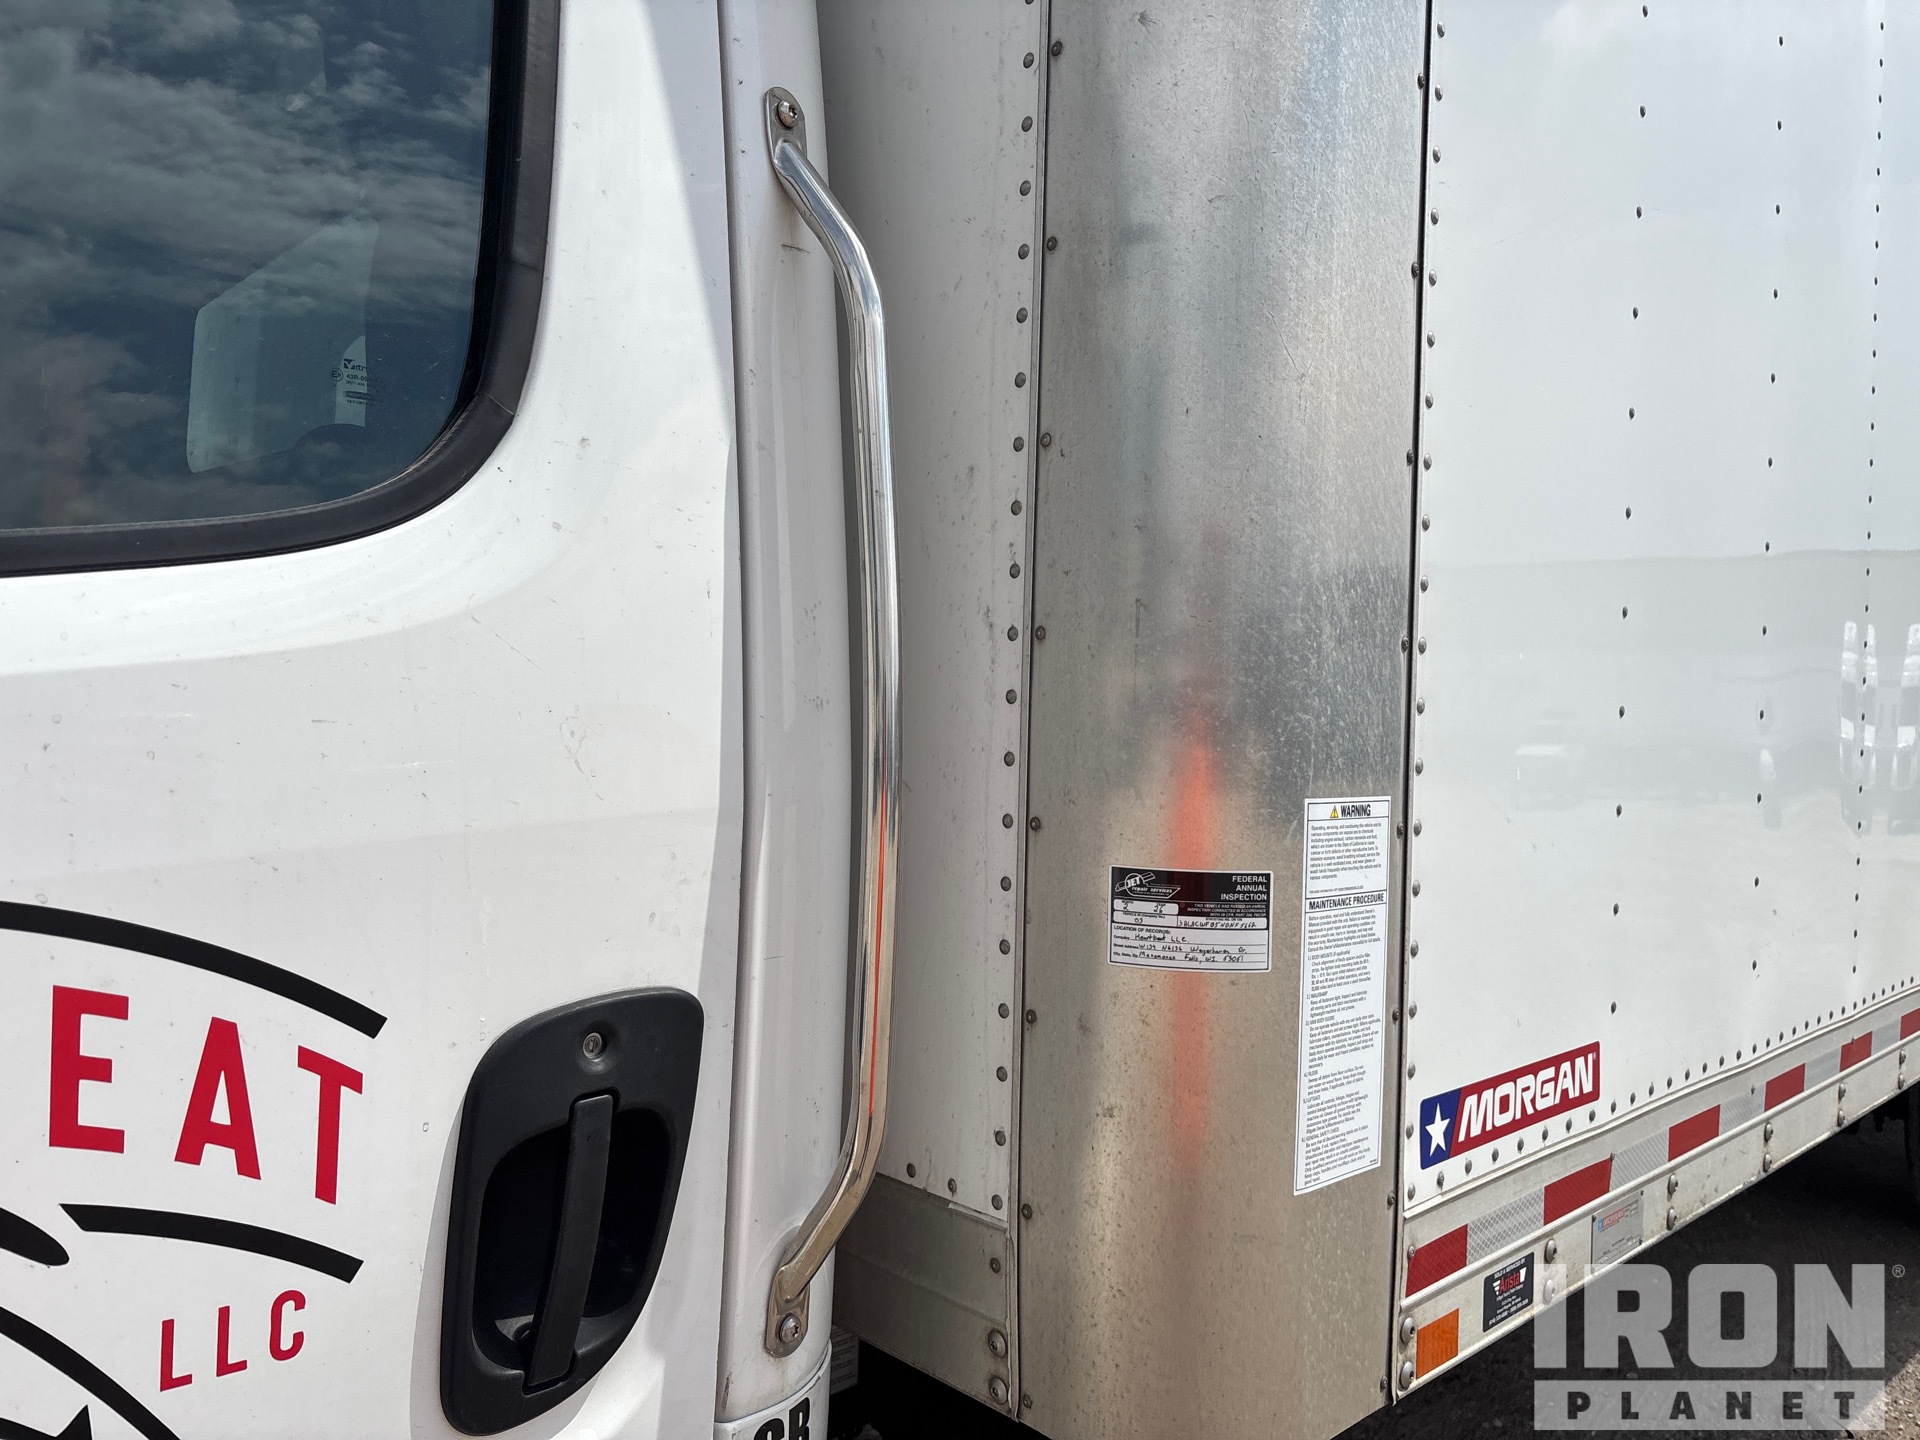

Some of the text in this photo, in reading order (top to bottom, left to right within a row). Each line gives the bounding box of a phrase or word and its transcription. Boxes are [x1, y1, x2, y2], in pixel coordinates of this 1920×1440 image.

[1341, 804, 1371, 817] WARNING
[1127, 876, 1140, 888] JET
[1309, 893, 1384, 910] MAINTENANCE PROCEDURE
[1458, 1052, 1593, 1142] MORGAN
[1500, 1271, 1520, 1296] Arista
[160, 1290, 306, 1392] LLC
